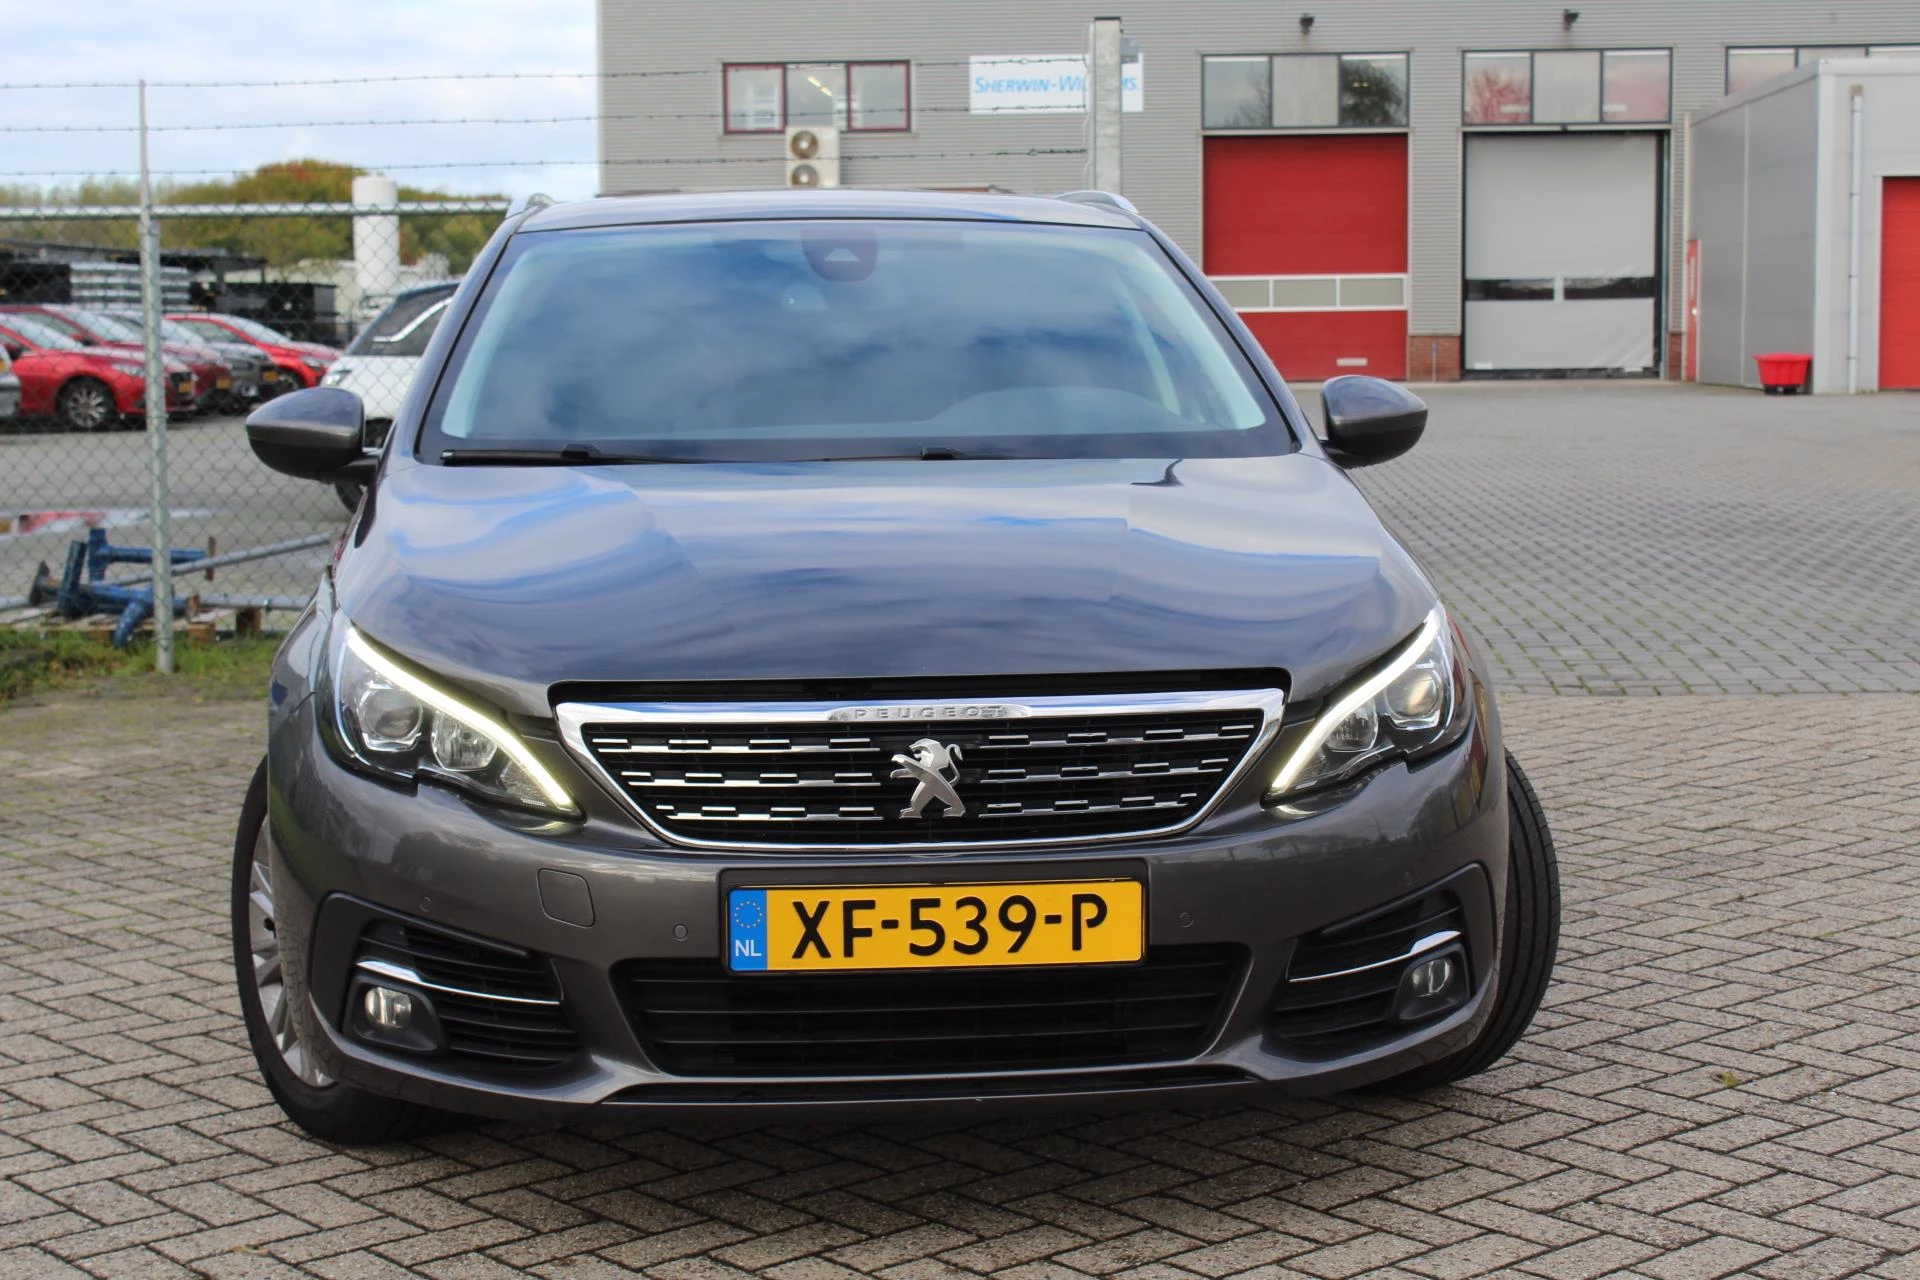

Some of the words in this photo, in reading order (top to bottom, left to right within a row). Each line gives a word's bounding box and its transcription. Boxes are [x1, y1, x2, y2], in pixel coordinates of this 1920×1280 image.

[855, 706, 1004, 719] PEUGEOT
[791, 893, 1108, 959] XF-539-P
[734, 939, 762, 957] NL
